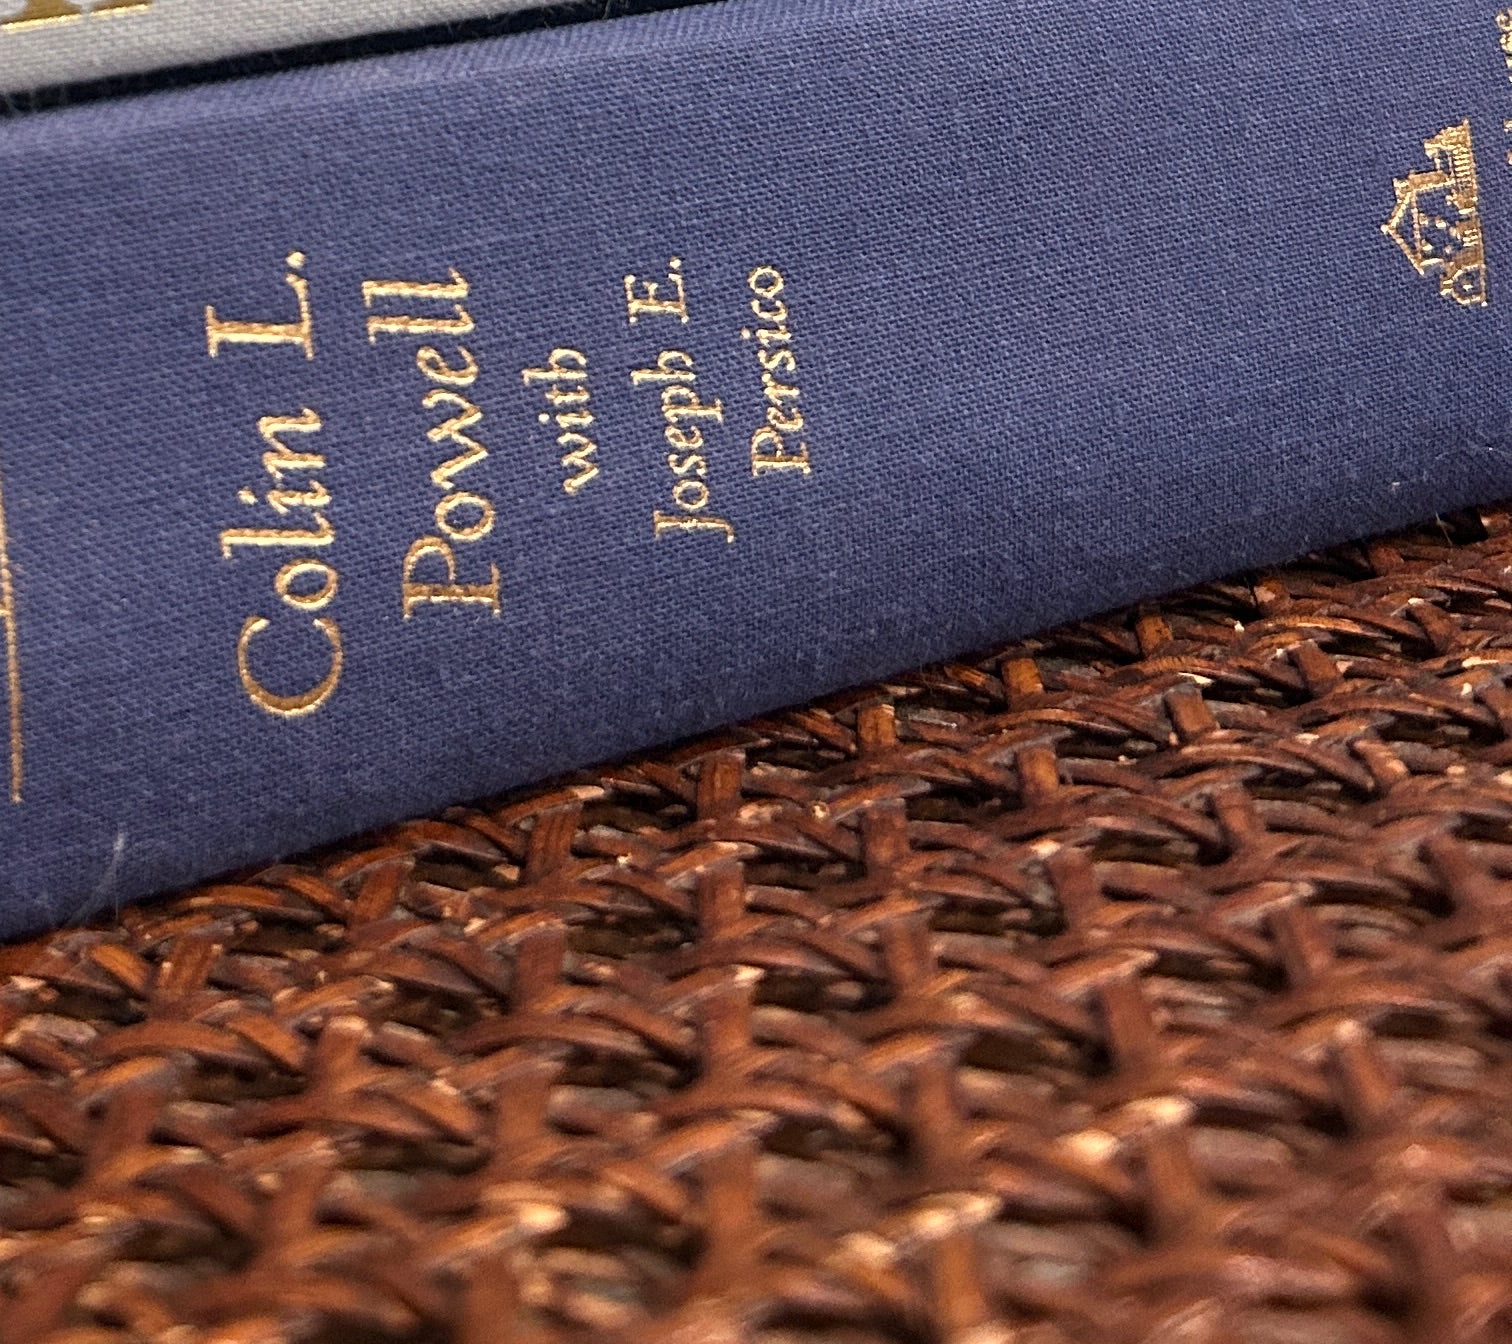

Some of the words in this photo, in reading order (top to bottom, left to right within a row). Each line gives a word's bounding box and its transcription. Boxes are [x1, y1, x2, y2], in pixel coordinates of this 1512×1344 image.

[204, 249, 315, 360] L.
[623, 255, 690, 326] E.
[740, 264, 813, 478] Persico
[361, 266, 502, 621] Powell
[522, 346, 600, 495] with
[630, 349, 735, 544] Joseph
[219, 406, 344, 716] Colin
